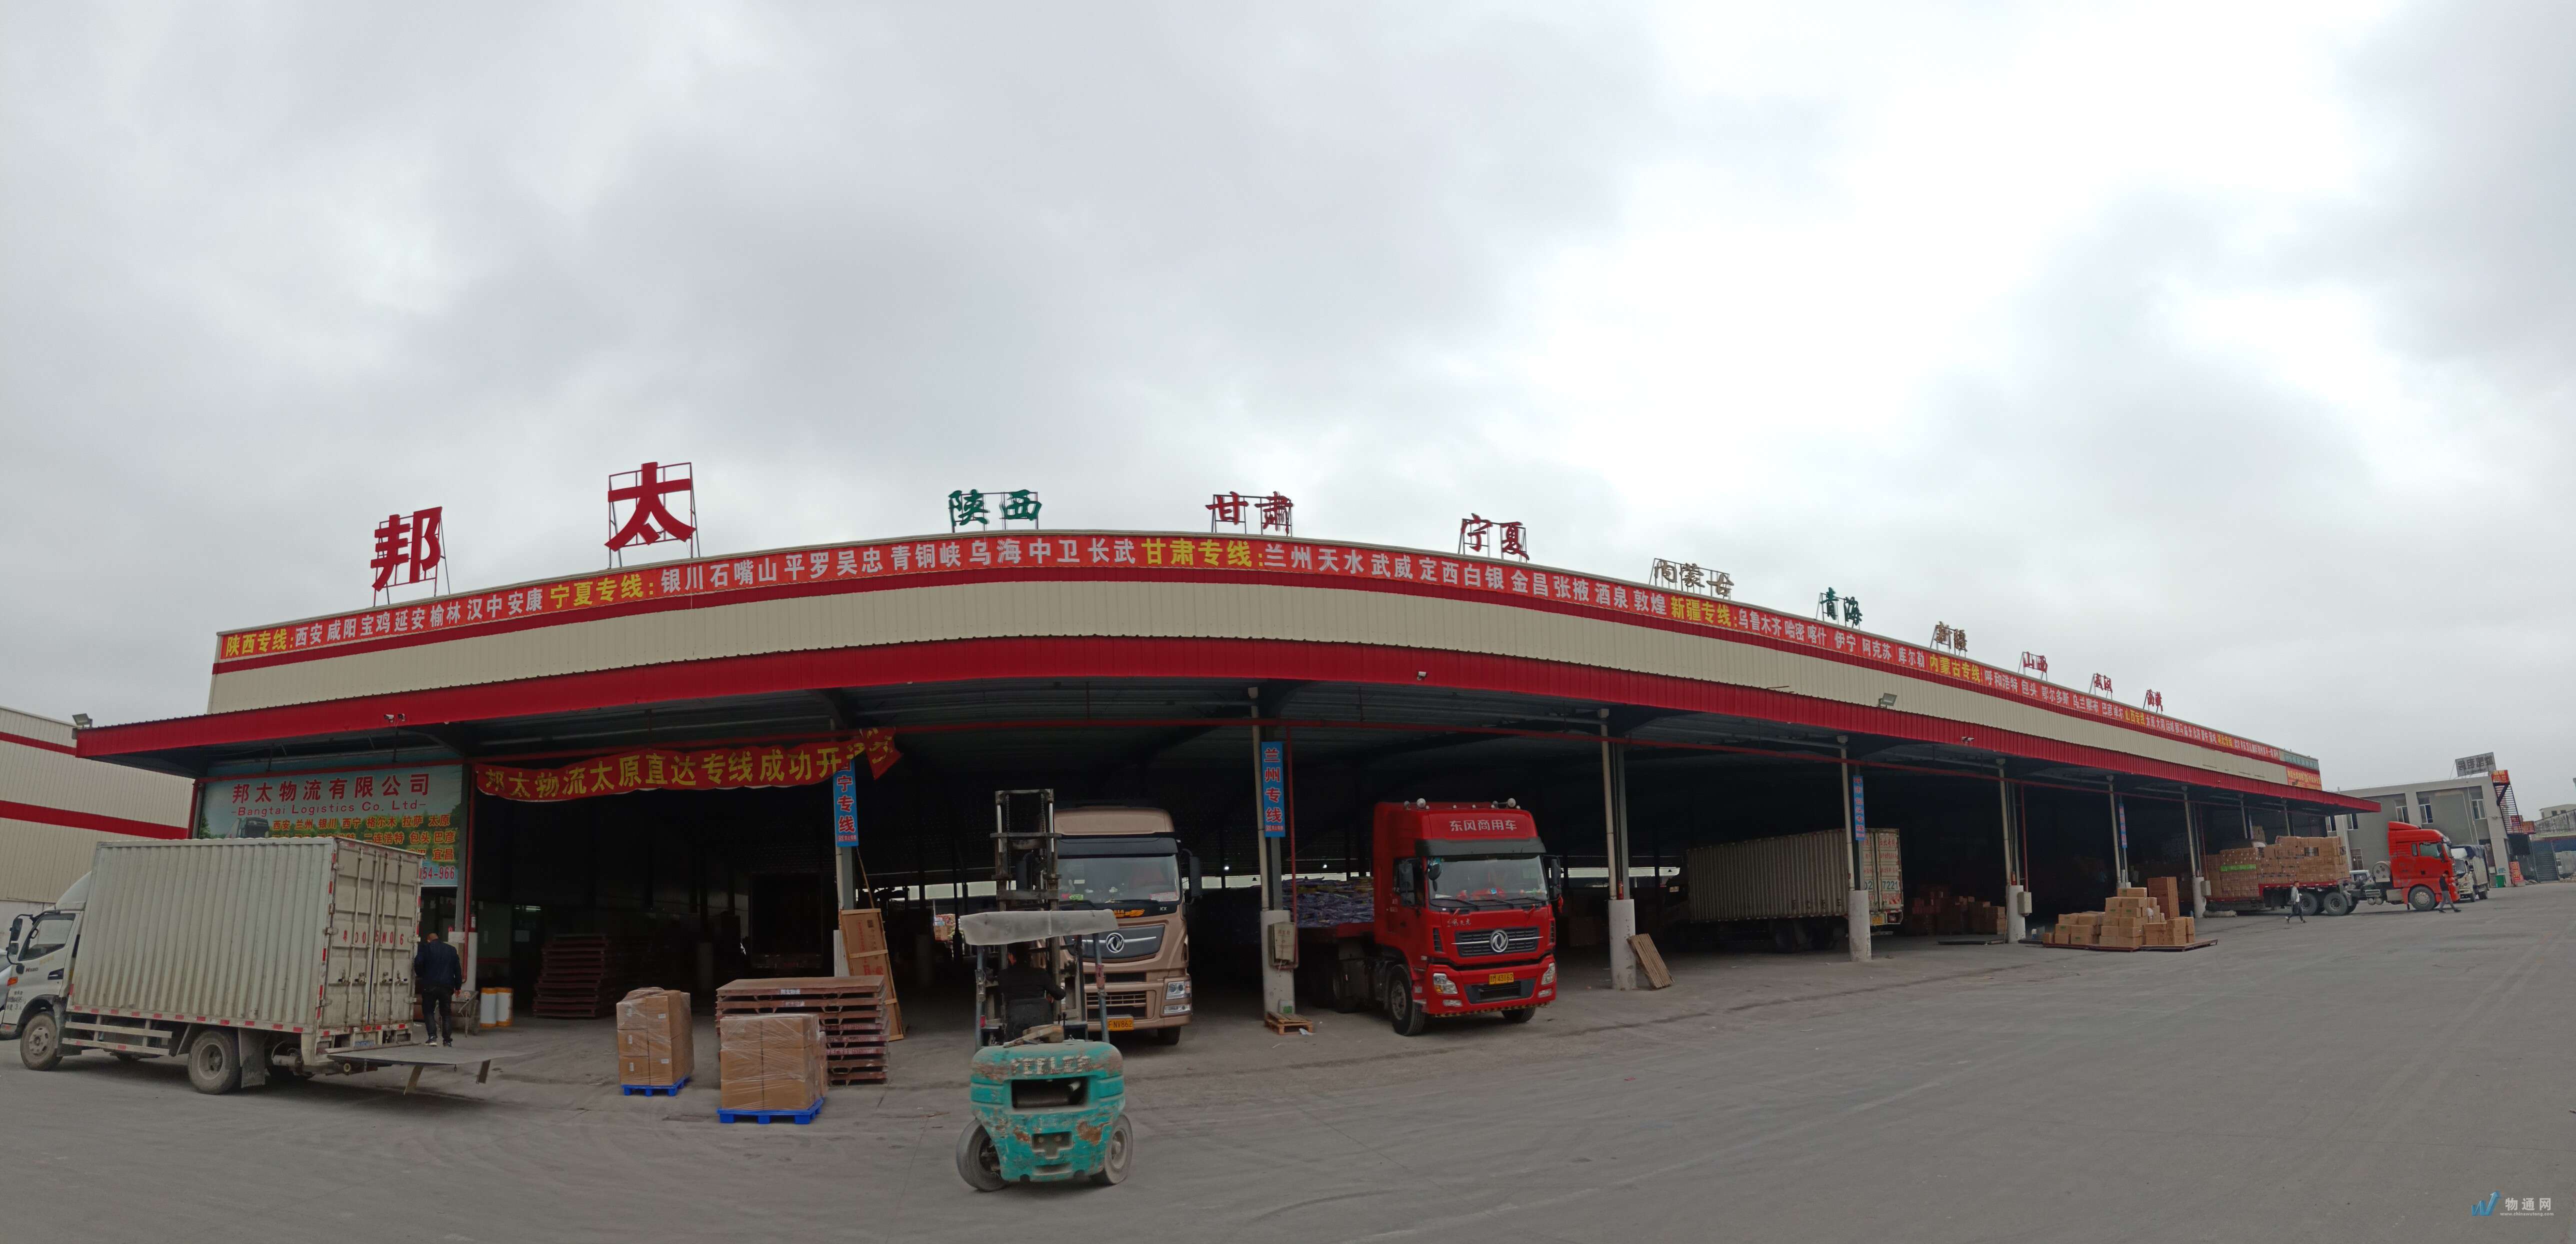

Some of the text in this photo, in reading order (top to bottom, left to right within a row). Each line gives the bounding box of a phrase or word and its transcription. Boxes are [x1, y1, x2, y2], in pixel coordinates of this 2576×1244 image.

[948, 489, 1042, 526] 陕西
[1206, 491, 1293, 536] 甘肃
[370, 462, 696, 592] 邦 太
[1460, 513, 1530, 560] 宁夏
[1654, 558, 1734, 596] 内蒙古
[296, 624, 323, 647] 西安
[327, 618, 356, 642] 咸阳
[360, 612, 390, 636] 宝鸡
[394, 608, 425, 632] 延安
[430, 602, 460, 627] 榆林
[467, 594, 502, 621] 汉中
[508, 588, 542, 616] 安康
[661, 566, 703, 594] 银川
[710, 558, 776, 588] 石嘴山
[784, 552, 829, 580] 平罗
[836, 548, 883, 576] 吴忠
[890, 542, 961, 570] 青铜峡
[969, 538, 1022, 566] 乌海
[1029, 538, 1080, 564] 中卫
[1088, 538, 1136, 564] 长武
[1264, 544, 1313, 570] 兰州
[1318, 548, 1364, 574] 天水
[1371, 554, 1414, 579] 武威
[1419, 557, 1458, 584] 定西
[1464, 564, 1505, 590] 白银
[1510, 570, 1548, 597] 金昌
[1554, 576, 1590, 602] 张掖
[1595, 582, 1628, 608] 酒泉
[1633, 590, 1667, 615] 敦煌
[1738, 608, 1782, 636] 乌鲁木齐
[1784, 620, 1804, 642] 哈密
[1807, 625, 1827, 646] 喀什
[1834, 631, 1856, 652] 伊宁
[1862, 638, 1892, 660] 阿克苏
[1898, 646, 1924, 668] 库尔勒
[1820, 587, 1862, 626] 青海
[232, 774, 429, 804] 邦太物流有限公司
[837, 762, 856, 833] 宁专线
[1264, 748, 1282, 823] 兰州专线
[273, 814, 450, 830] 西安 兰州 银川 西宁 格尔木 拉萨 太原
[292, 802, 354, 816] Logistics
[1450, 820, 1517, 831] 东风商用车
[410, 832, 430, 844] 包头
[434, 831, 456, 844] 巴彦
[432, 848, 454, 861] 宜昌
[1882, 880, 1898, 890] 7221
